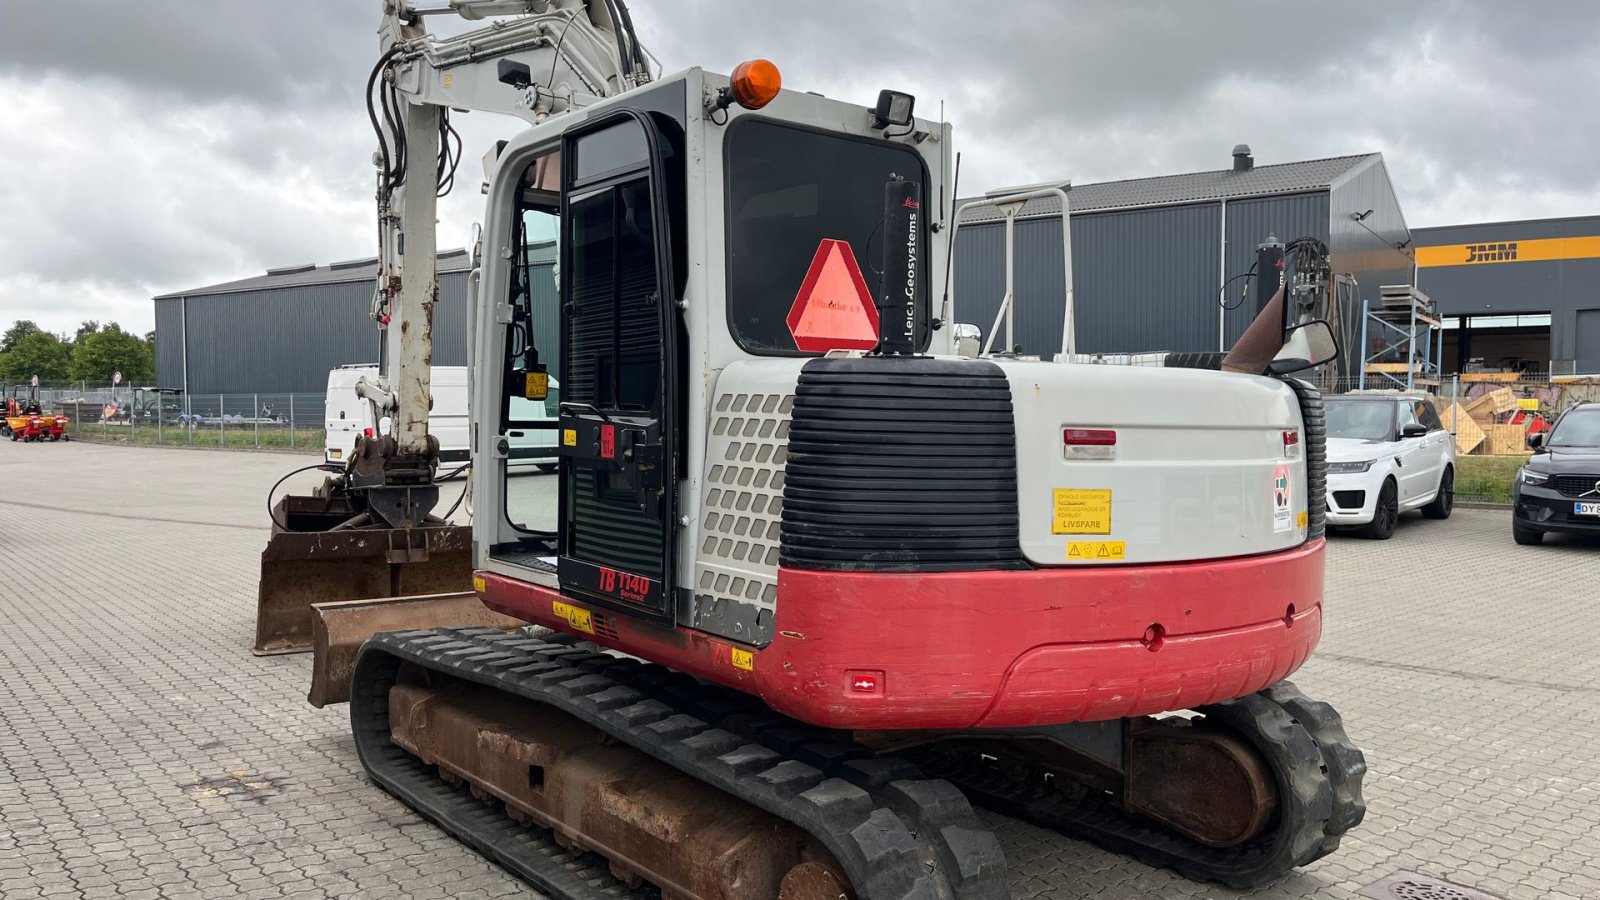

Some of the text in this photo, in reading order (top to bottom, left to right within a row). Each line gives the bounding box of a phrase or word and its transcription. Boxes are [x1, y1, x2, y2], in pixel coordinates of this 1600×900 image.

[904, 213, 917, 297] Geosystems
[1465, 243, 1517, 262] JMM
[1581, 505, 1594, 513] DY
[1063, 520, 1101, 528] LIVSFARE
[599, 566, 650, 595] TB 1140
[620, 589, 645, 602] Series2
